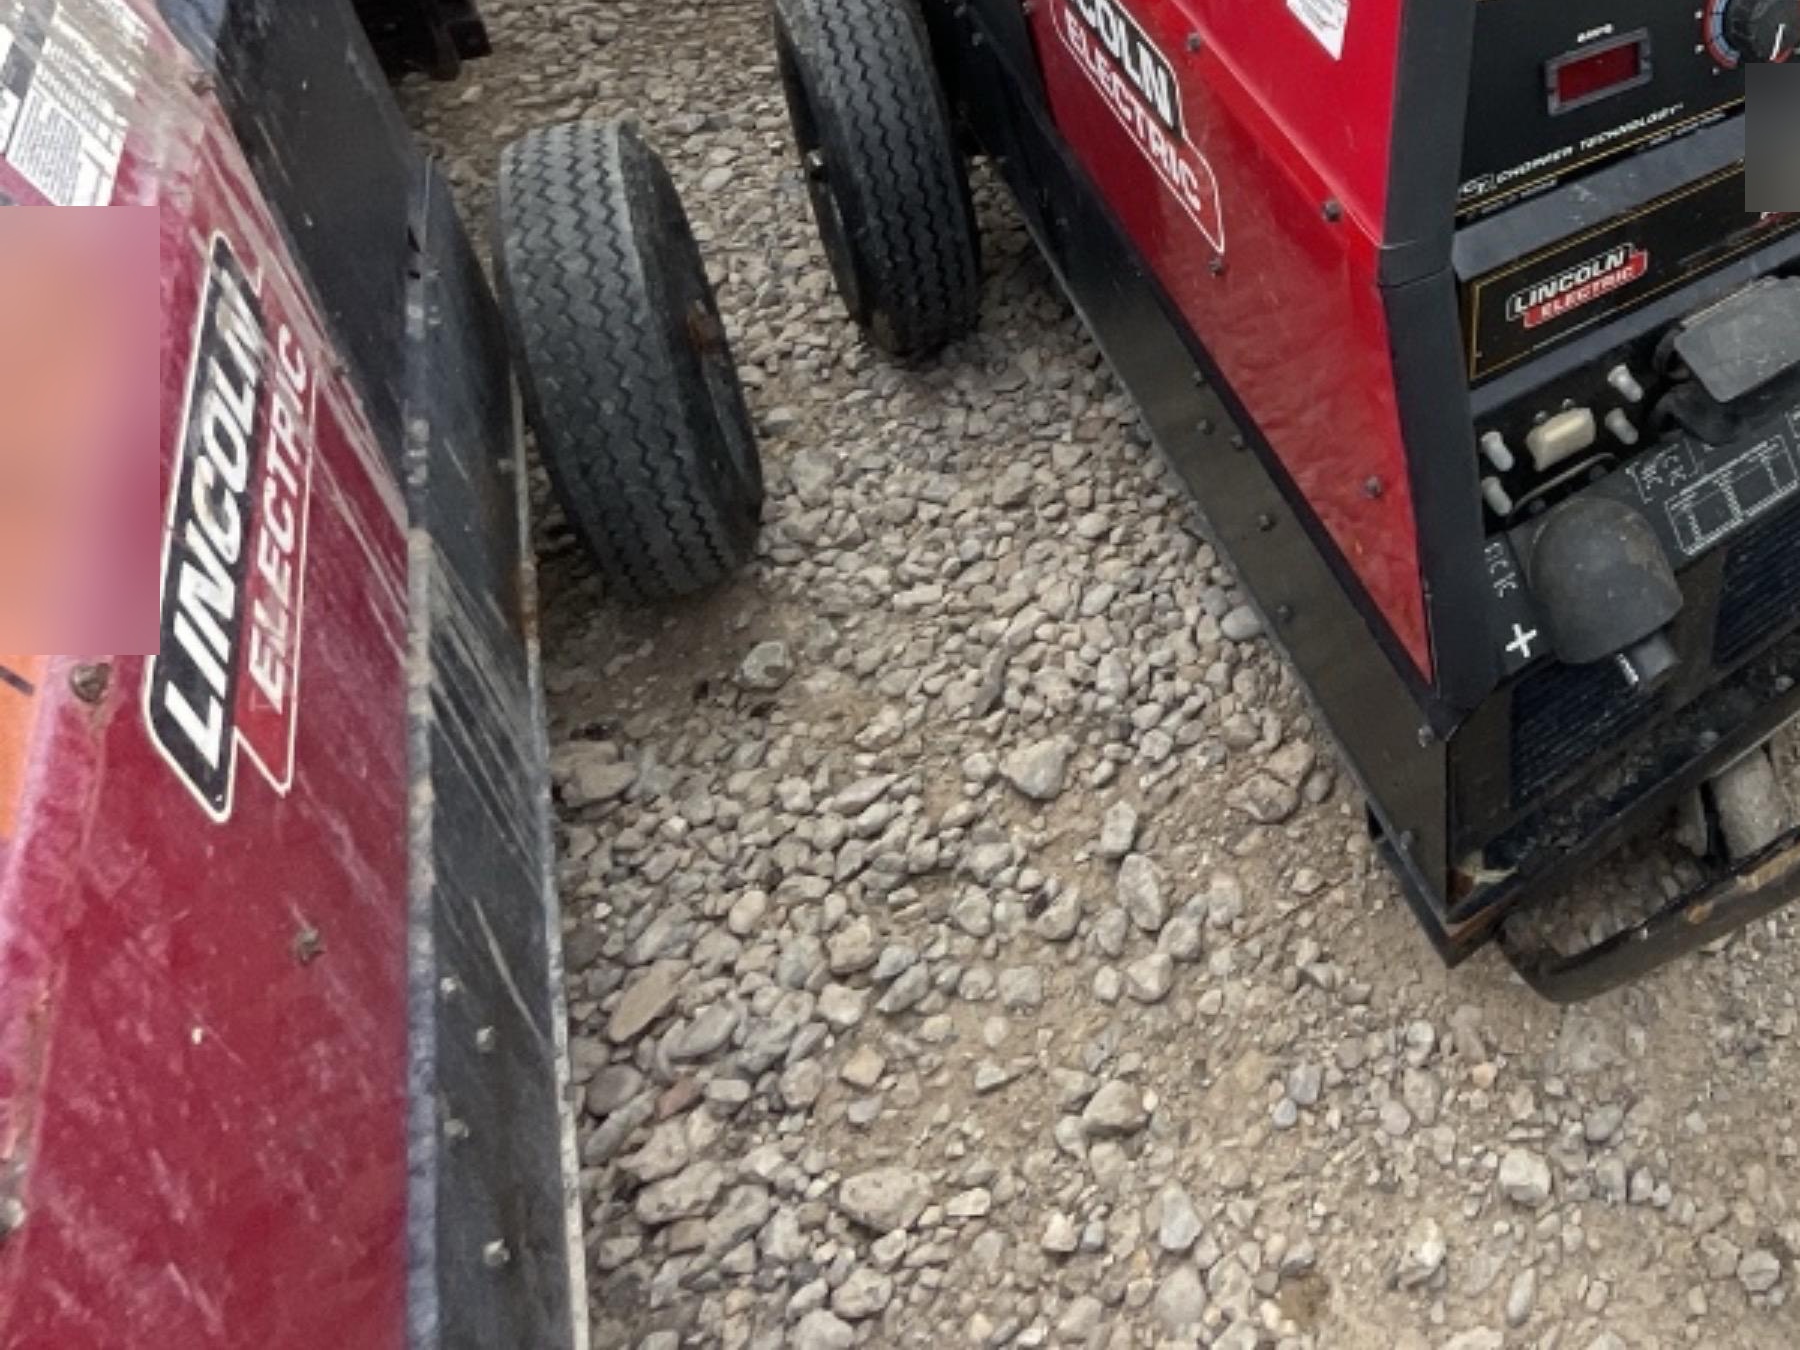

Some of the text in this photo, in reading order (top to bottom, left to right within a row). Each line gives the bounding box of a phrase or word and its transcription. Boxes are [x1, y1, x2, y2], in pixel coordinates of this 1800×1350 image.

[1064, 9, 1201, 211] ELECTRIC
[1513, 248, 1626, 313] LINCOLN
[164, 272, 265, 774] LINCOLN
[248, 321, 312, 713] ELECTRIC
